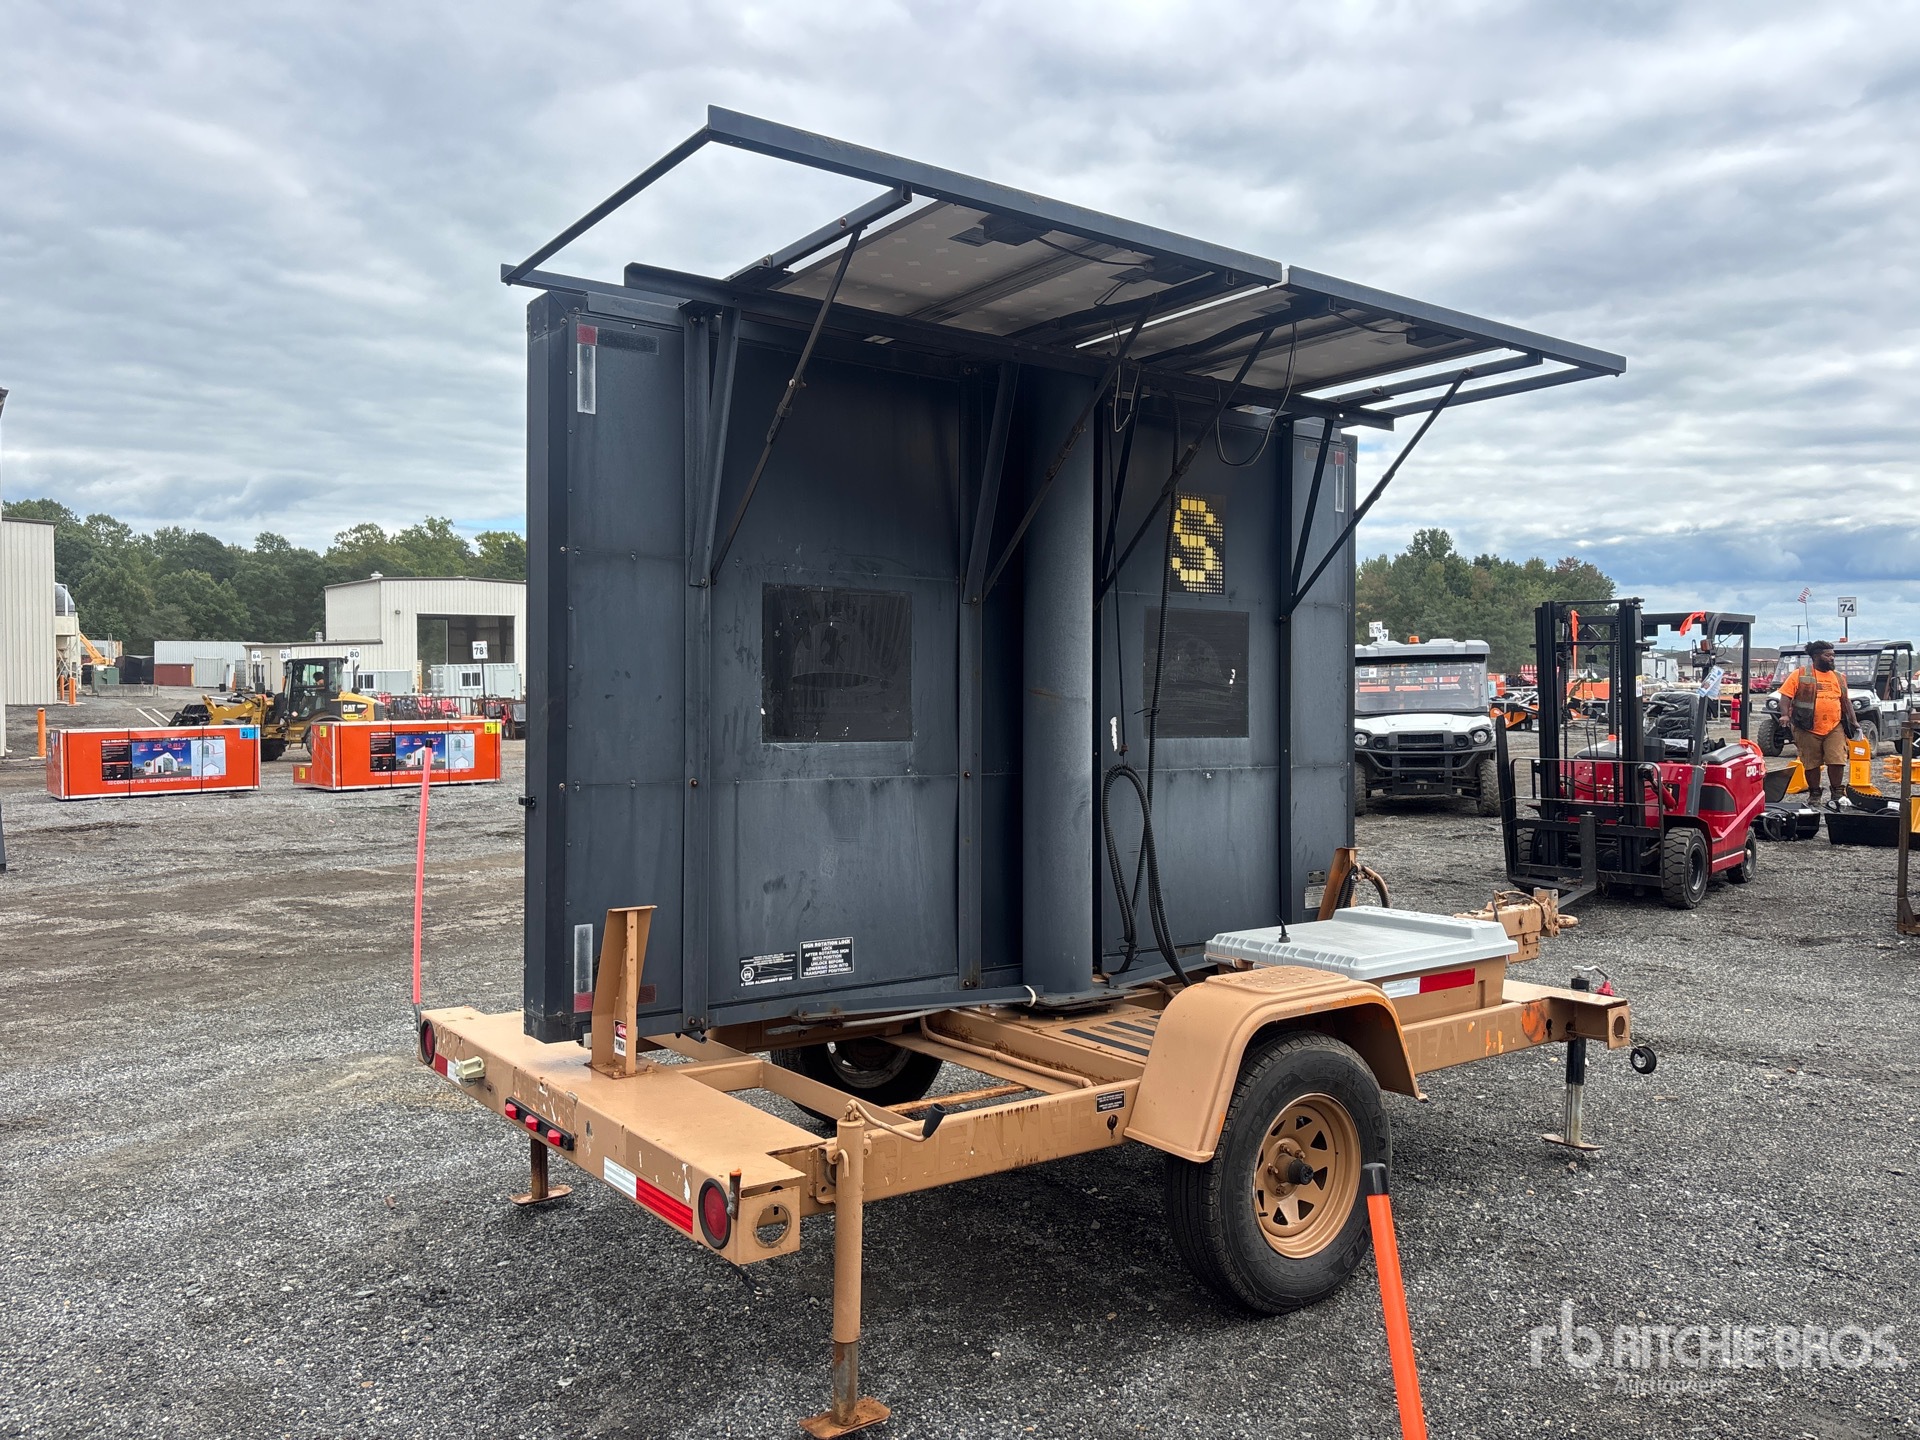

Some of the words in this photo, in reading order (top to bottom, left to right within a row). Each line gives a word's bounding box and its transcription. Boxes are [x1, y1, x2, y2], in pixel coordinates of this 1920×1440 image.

[1840, 604, 1854, 612] 74
[474, 647, 484, 655] 78
[343, 704, 356, 712] CAT
